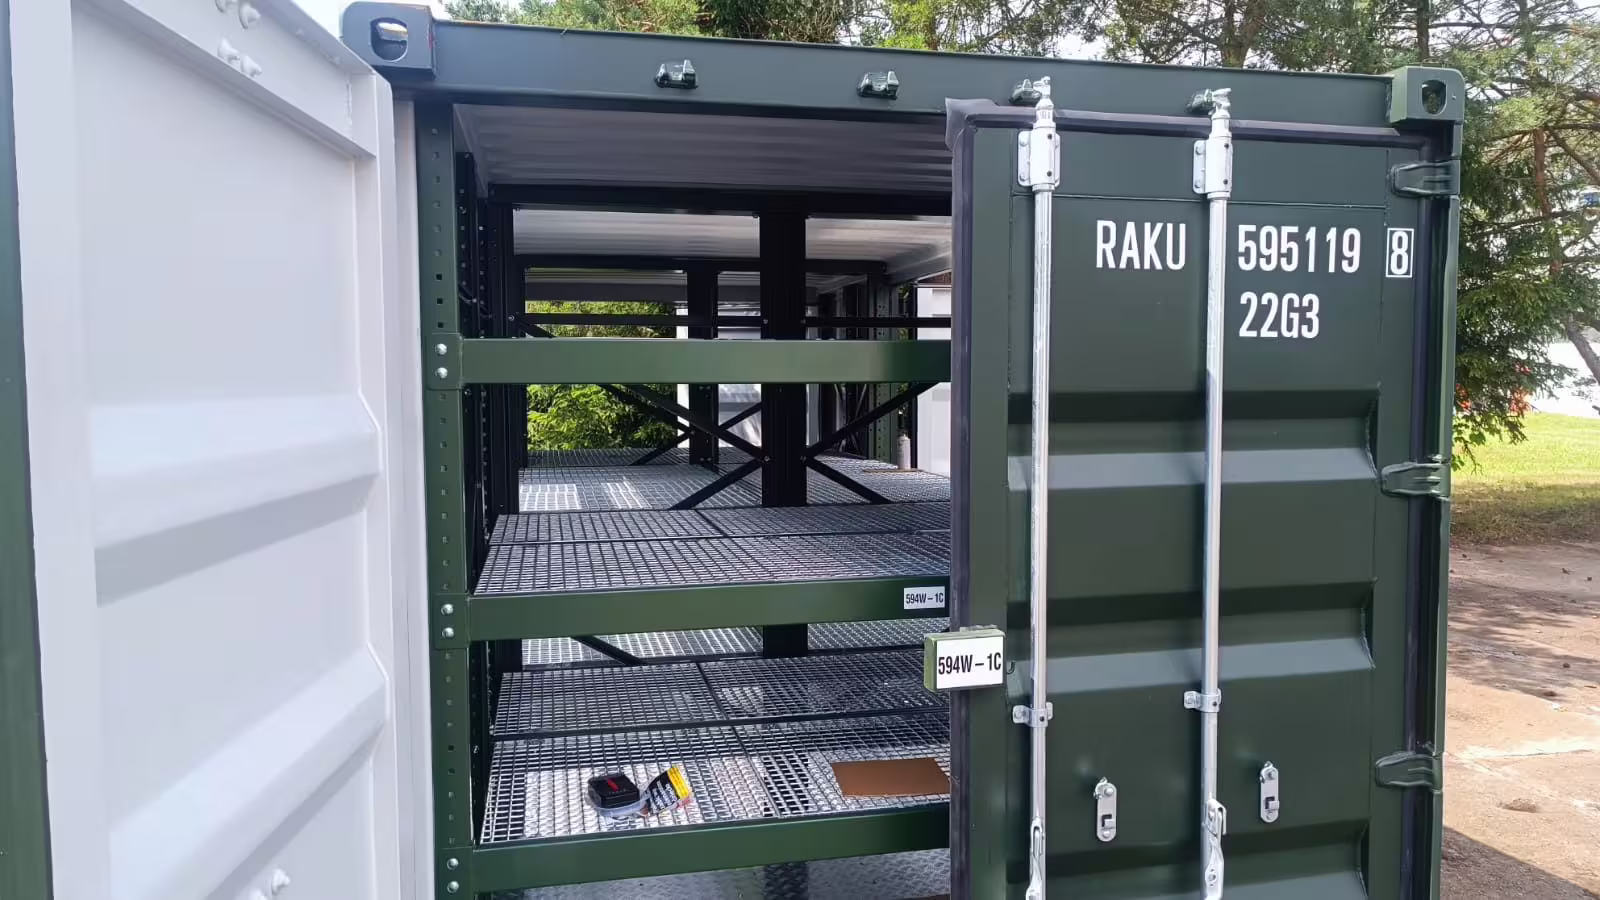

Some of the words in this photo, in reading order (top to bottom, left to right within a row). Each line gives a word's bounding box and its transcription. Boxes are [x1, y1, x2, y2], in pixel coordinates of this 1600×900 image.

[1096, 220, 1186, 270] RAKU
[1238, 225, 1361, 273] 595119
[1389, 230, 1410, 275] 8
[1239, 292, 1320, 338] 22G3
